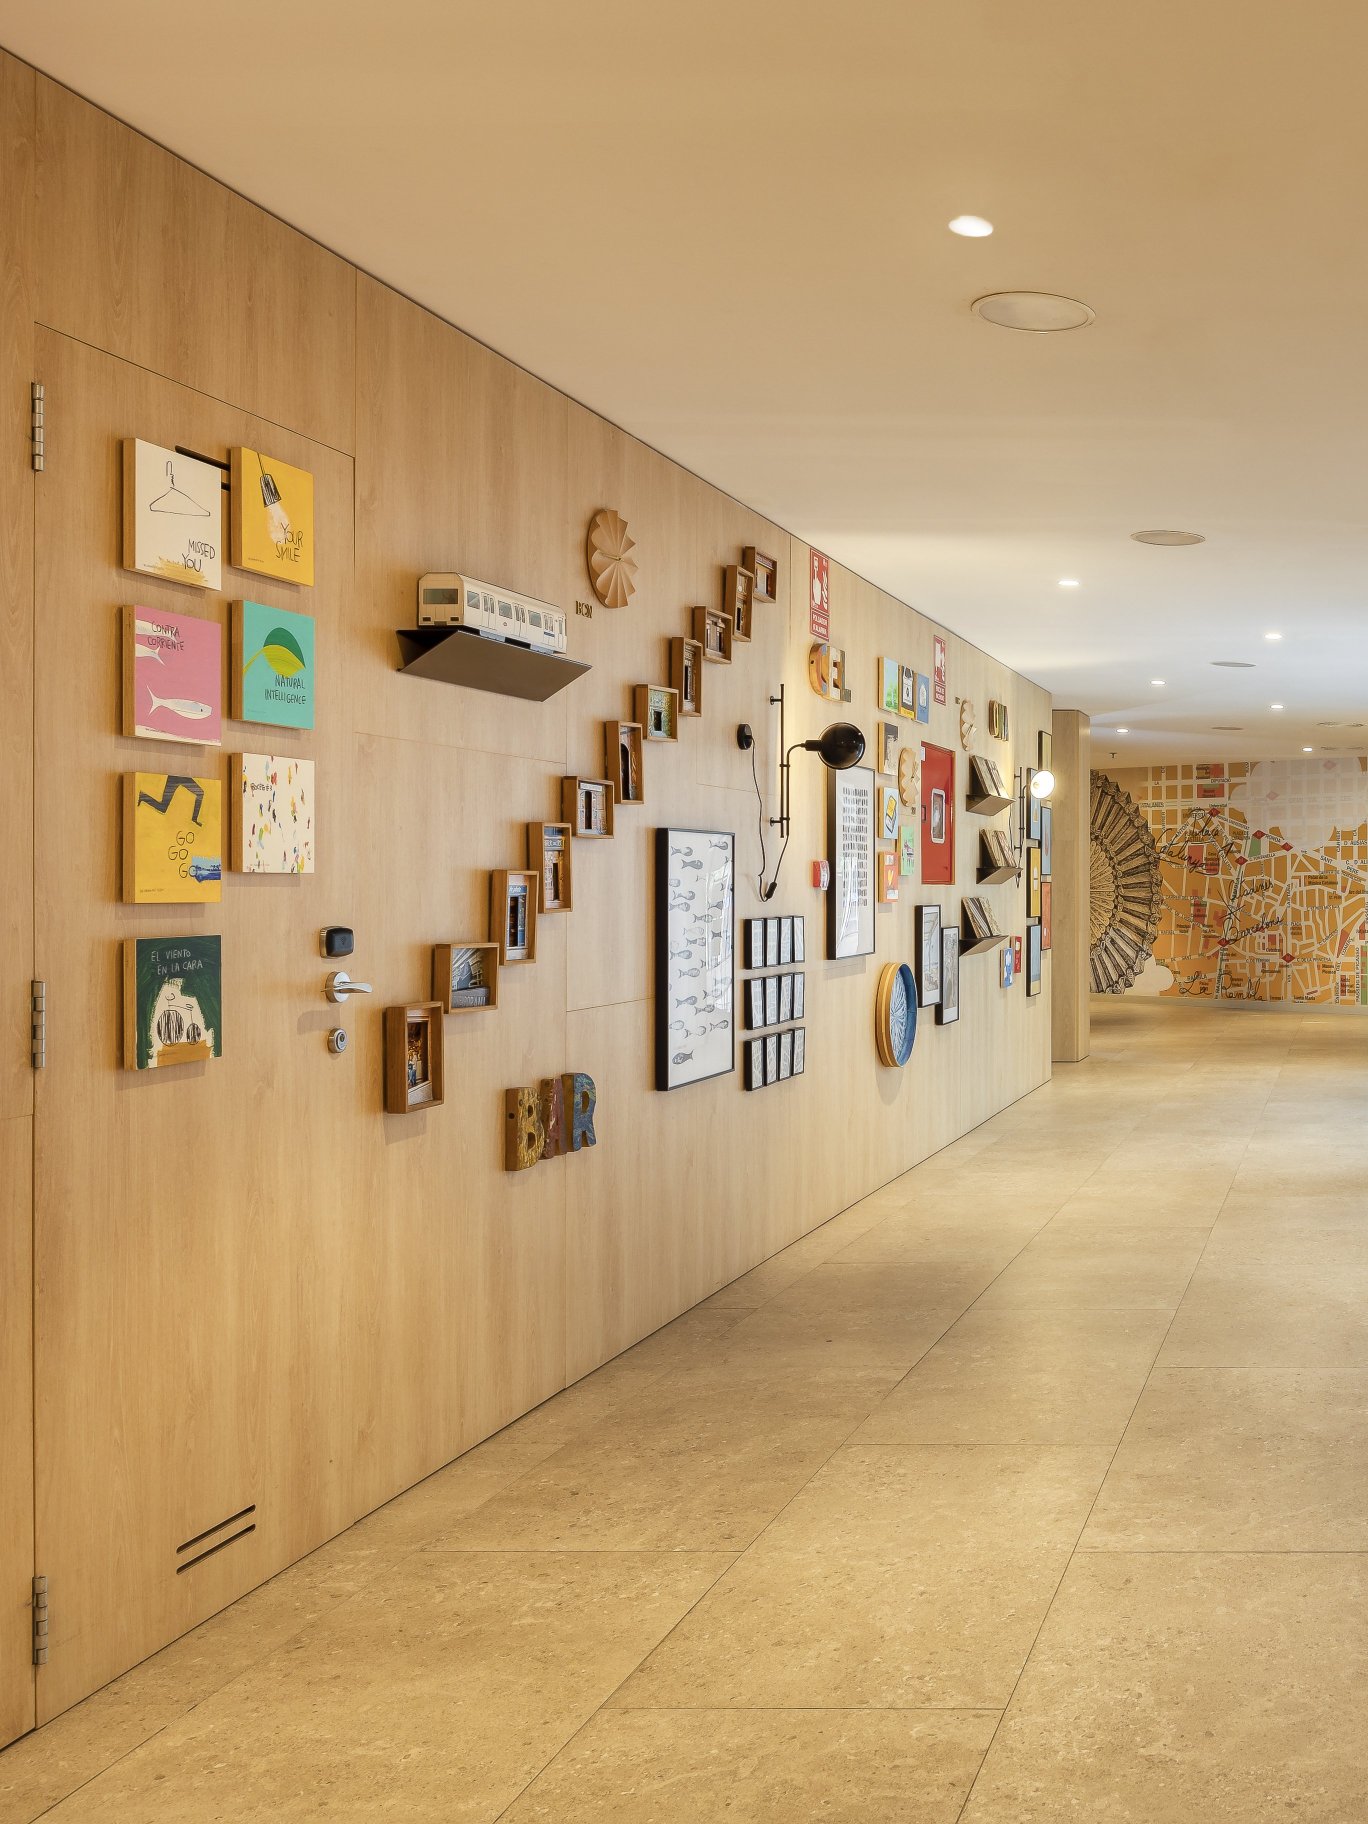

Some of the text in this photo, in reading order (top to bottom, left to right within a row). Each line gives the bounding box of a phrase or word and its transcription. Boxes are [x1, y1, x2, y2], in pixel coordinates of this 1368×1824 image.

[280, 522, 304, 548] YOUR
[188, 539, 216, 560] MISSED
[275, 541, 301, 563] SMILE
[182, 554, 202, 573] YOU
[151, 620, 180, 638] CONTRA
[147, 634, 185, 651] CORRIENTE
[275, 674, 306, 690] NATURAL
[264, 688, 307, 705] INTELLIGENCE
[176, 831, 195, 846] GO
[168, 845, 189, 861] GO
[1319, 855, 1333, 865] SANT
[178, 862, 199, 879] GO
[151, 949, 191, 962] EL VIENTO
[157, 959, 203, 975] EN LA CARA
[505, 1072, 597, 1171] BAR
